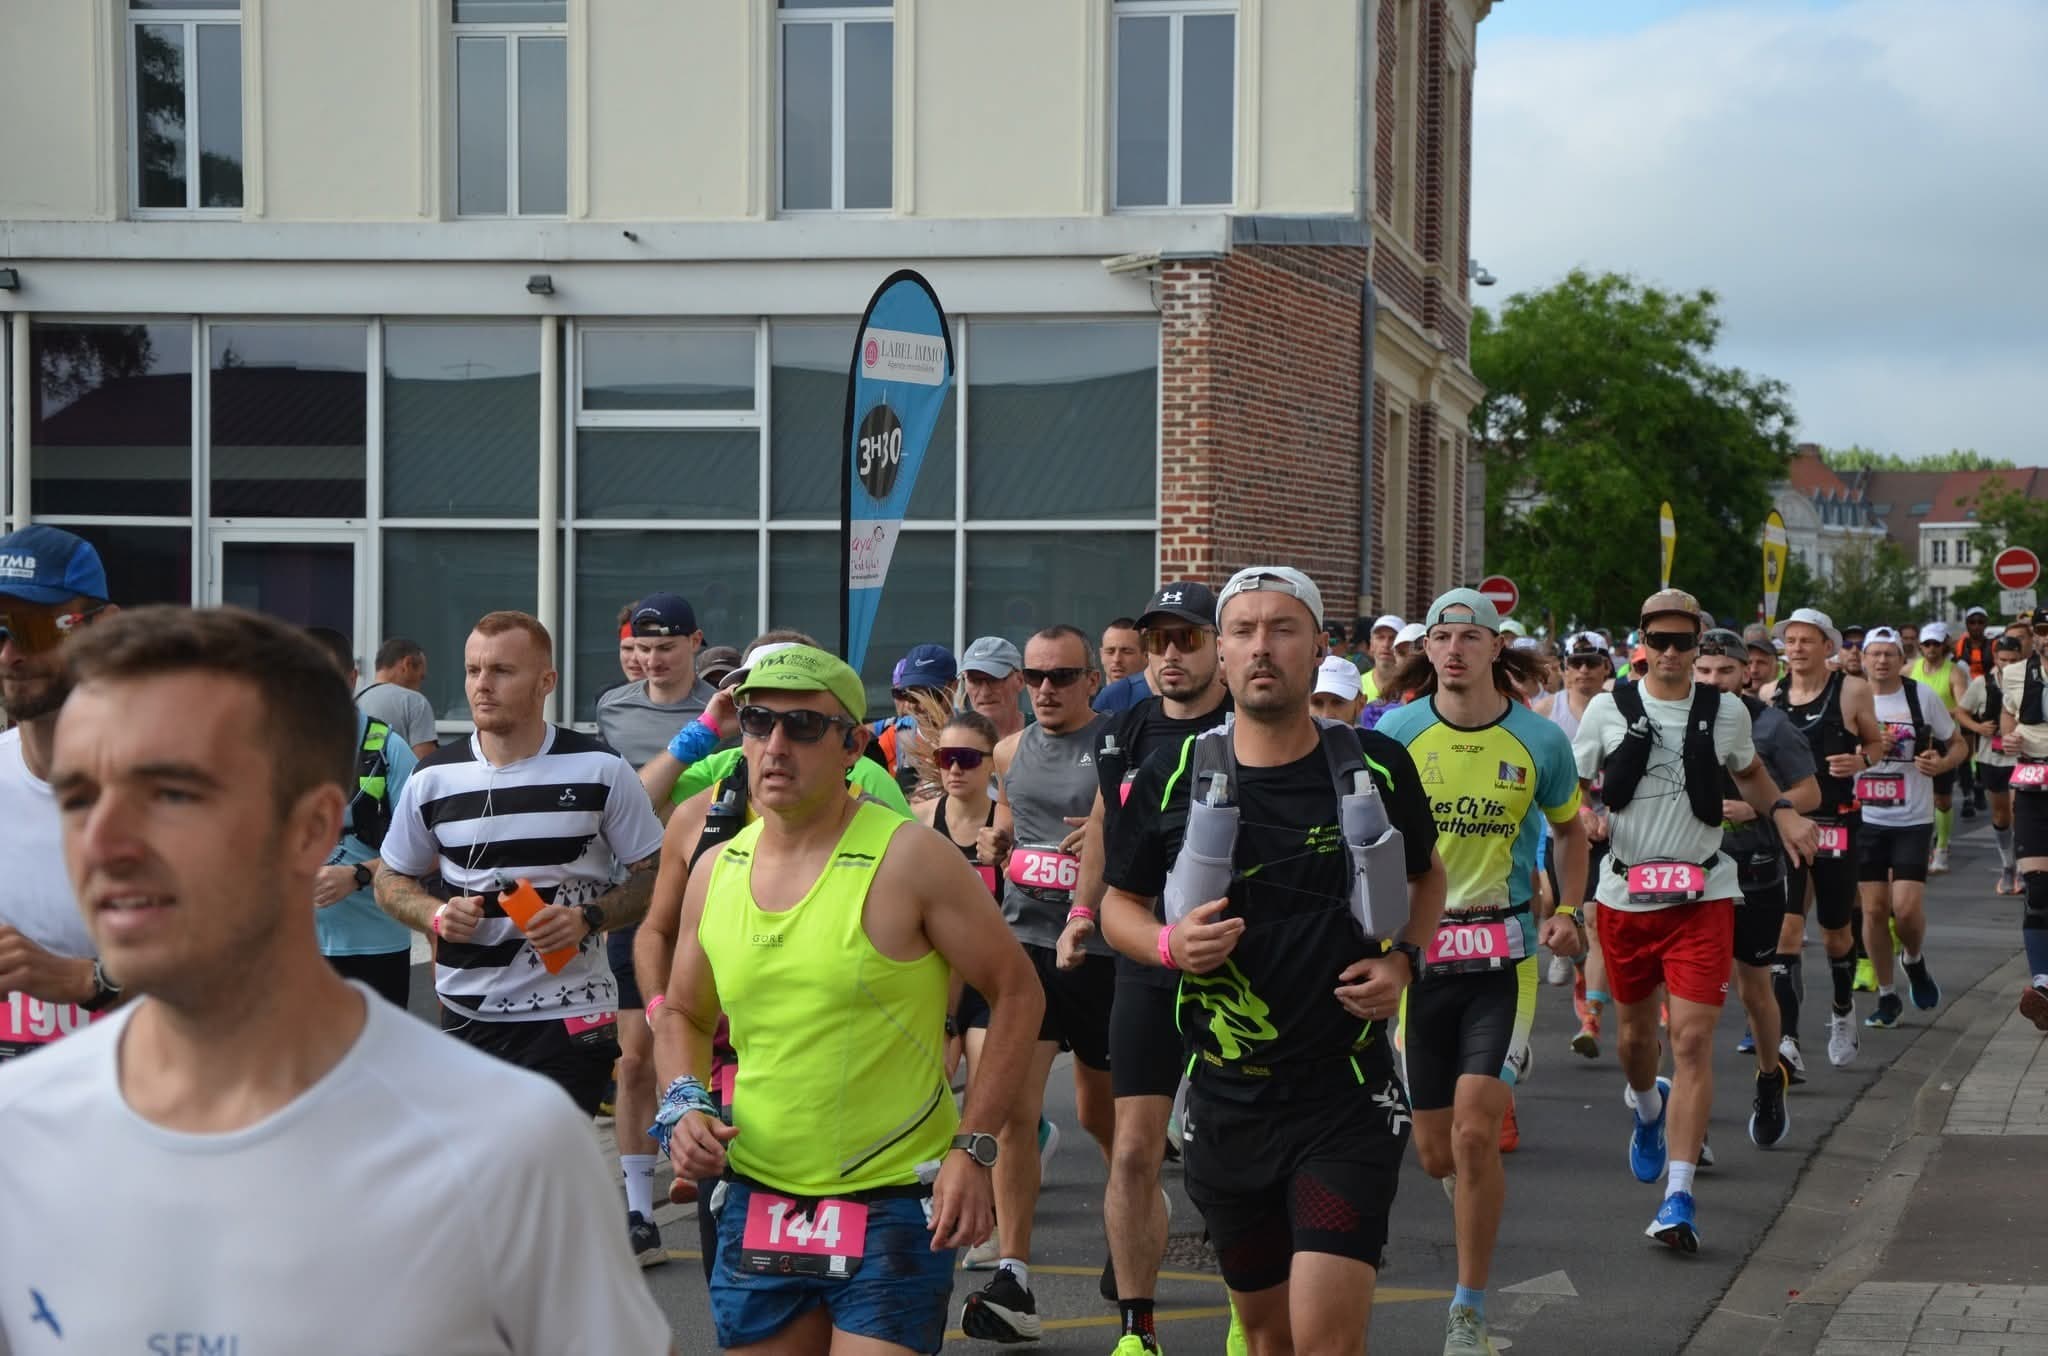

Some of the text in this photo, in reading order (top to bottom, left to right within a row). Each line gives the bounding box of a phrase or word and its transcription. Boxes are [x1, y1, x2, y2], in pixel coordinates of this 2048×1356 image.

[880, 339, 943, 362] LABEL IMMO
[860, 427, 902, 475] 3H30
[2017, 765, 2045, 783] 493
[1864, 781, 1897, 797] 166
[1456, 796, 1505, 819] Ch'tis
[1434, 817, 1516, 838] athoniens
[1022, 854, 1077, 886] 256
[1641, 866, 1691, 889] 373
[752, 934, 784, 943] GORE
[1438, 927, 1494, 958] 200
[8, 990, 90, 1037] 190
[767, 1202, 842, 1248] 144
[146, 1331, 240, 1356] SEMI
